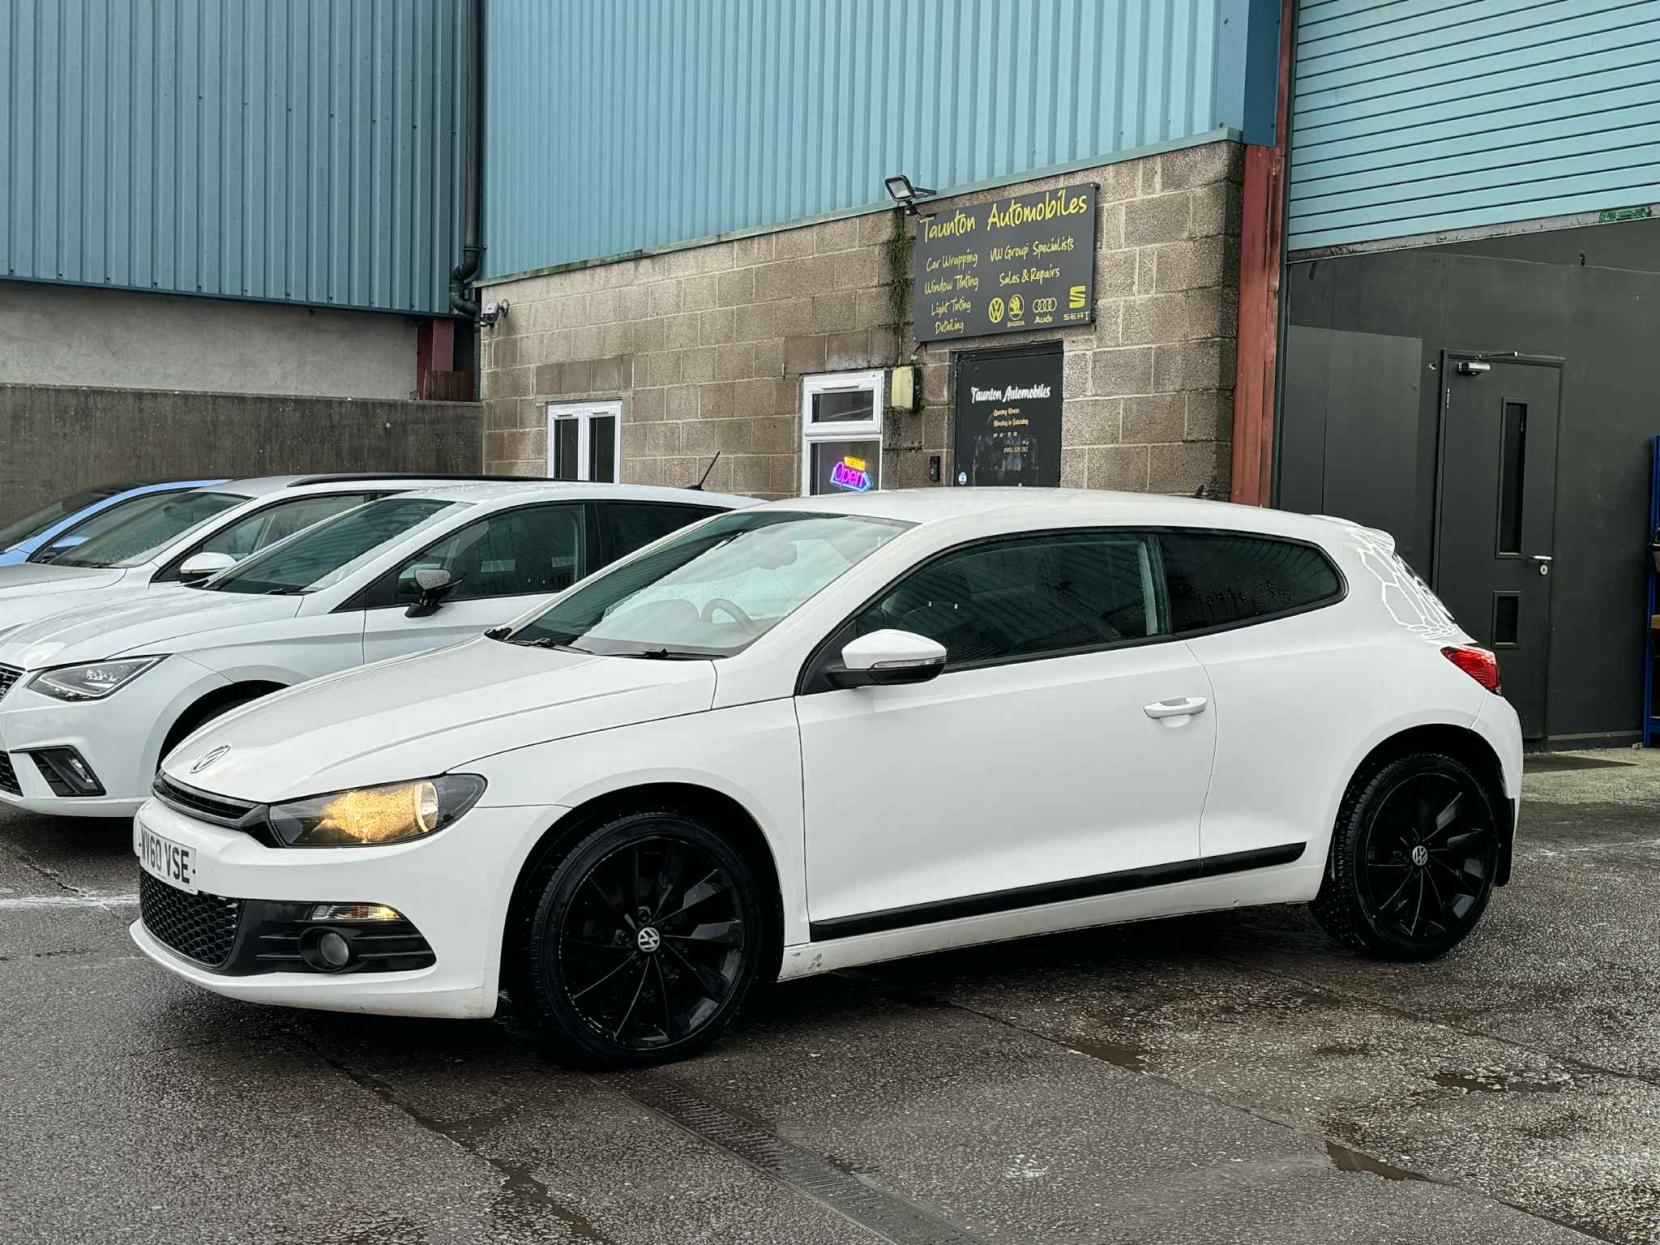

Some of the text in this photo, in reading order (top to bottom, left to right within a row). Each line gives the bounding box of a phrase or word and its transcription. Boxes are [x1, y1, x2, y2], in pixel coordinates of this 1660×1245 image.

[920, 189, 1087, 243] Taunton Automobiles
[1004, 243, 1029, 260] Group
[1033, 236, 1074, 258] Specialists
[926, 249, 978, 272] Car Wrapping
[924, 271, 979, 295] Window Tinting
[999, 271, 1020, 287] Sales
[1030, 264, 1060, 285] Repairs
[931, 296, 972, 318] Light Tinting
[1063, 311, 1090, 321] SEAT
[935, 318, 964, 335] Detailing
[1034, 315, 1053, 324] Audi
[970, 383, 1051, 404] Taunton Automobiles
[164, 841, 190, 885] VSE
